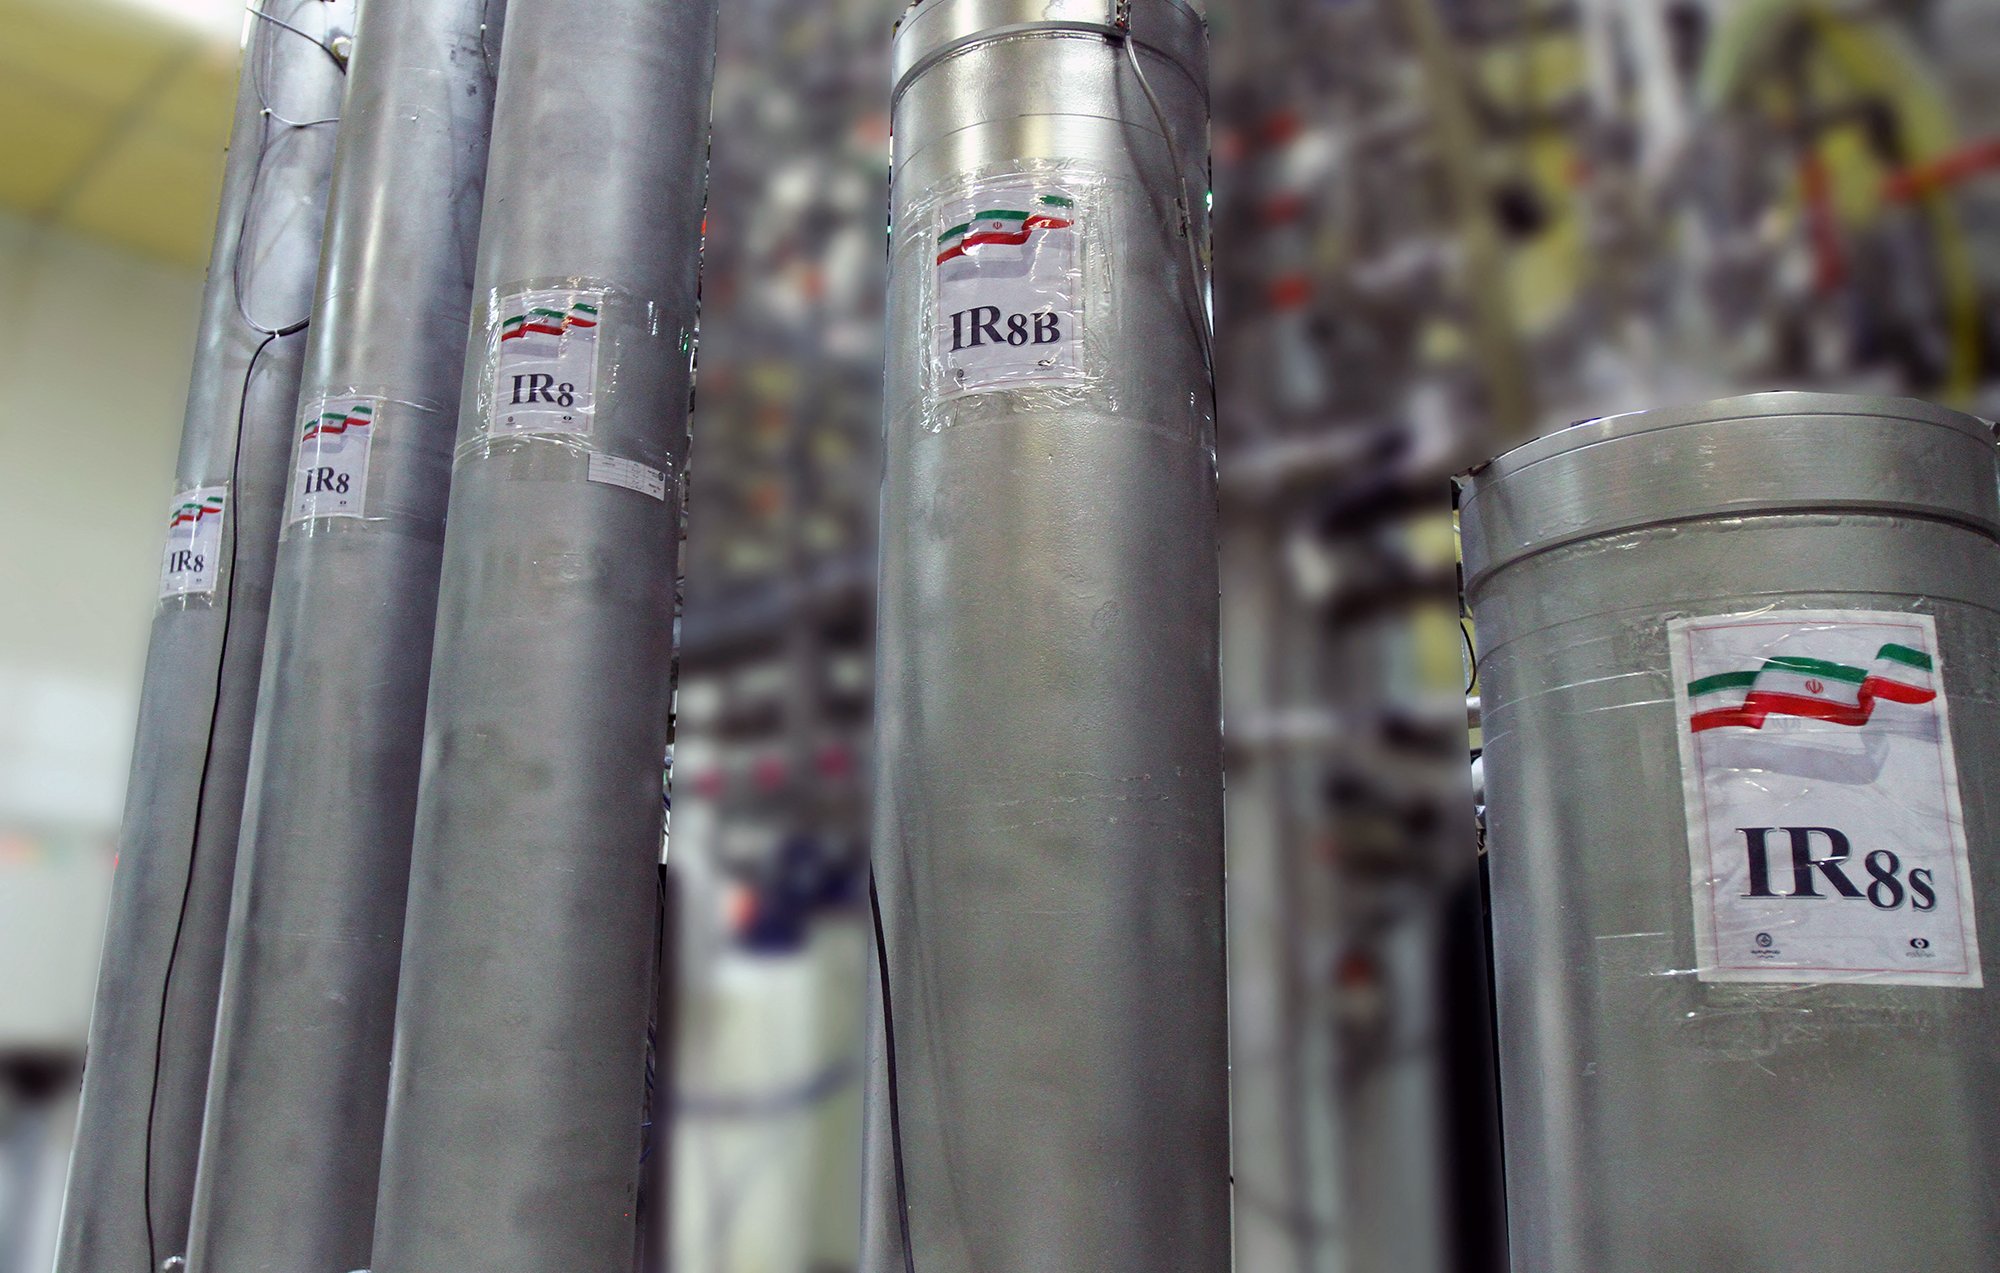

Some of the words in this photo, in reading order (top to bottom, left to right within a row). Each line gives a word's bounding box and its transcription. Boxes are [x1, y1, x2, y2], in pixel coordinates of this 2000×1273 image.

[949, 305, 1061, 353] IR8B
[509, 373, 575, 407] IR8
[304, 466, 350, 495] IR8
[169, 549, 204, 574] IR8
